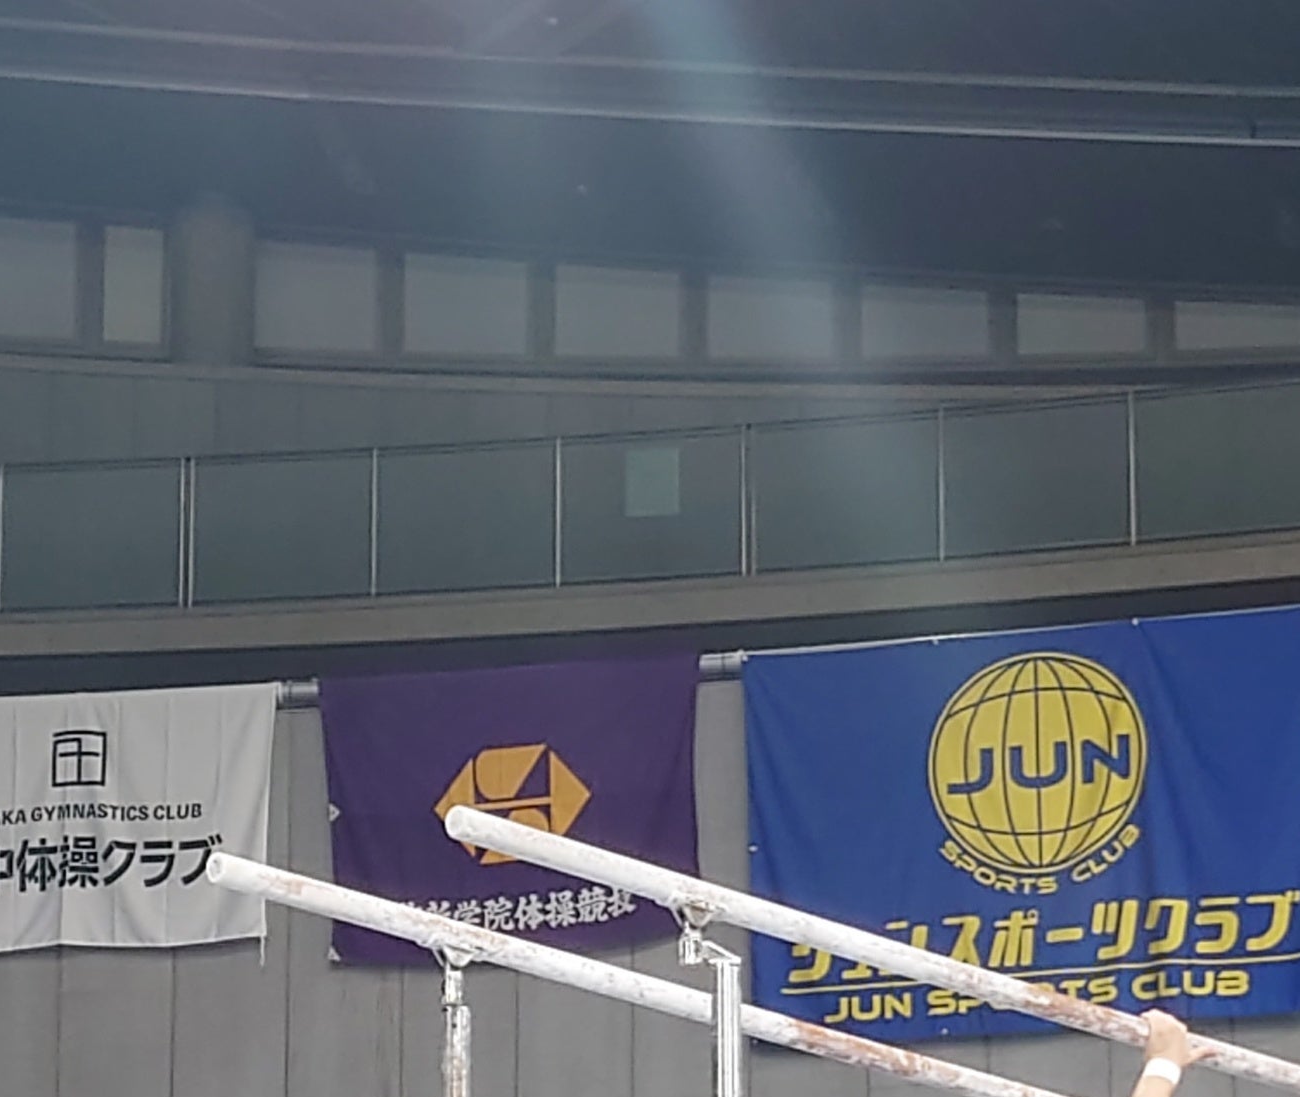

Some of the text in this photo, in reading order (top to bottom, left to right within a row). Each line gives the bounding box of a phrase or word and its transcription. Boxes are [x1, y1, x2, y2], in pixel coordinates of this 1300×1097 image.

[947, 734, 1130, 794] JUN
[31, 803, 149, 823] GYMNASTICS
[153, 803, 202, 821] CLUB
[939, 824, 1141, 894] SPORTS CLUB
[401, 886, 637, 931] 学院体操競技
[824, 969, 1249, 1024] JUN SPTS CLUB
